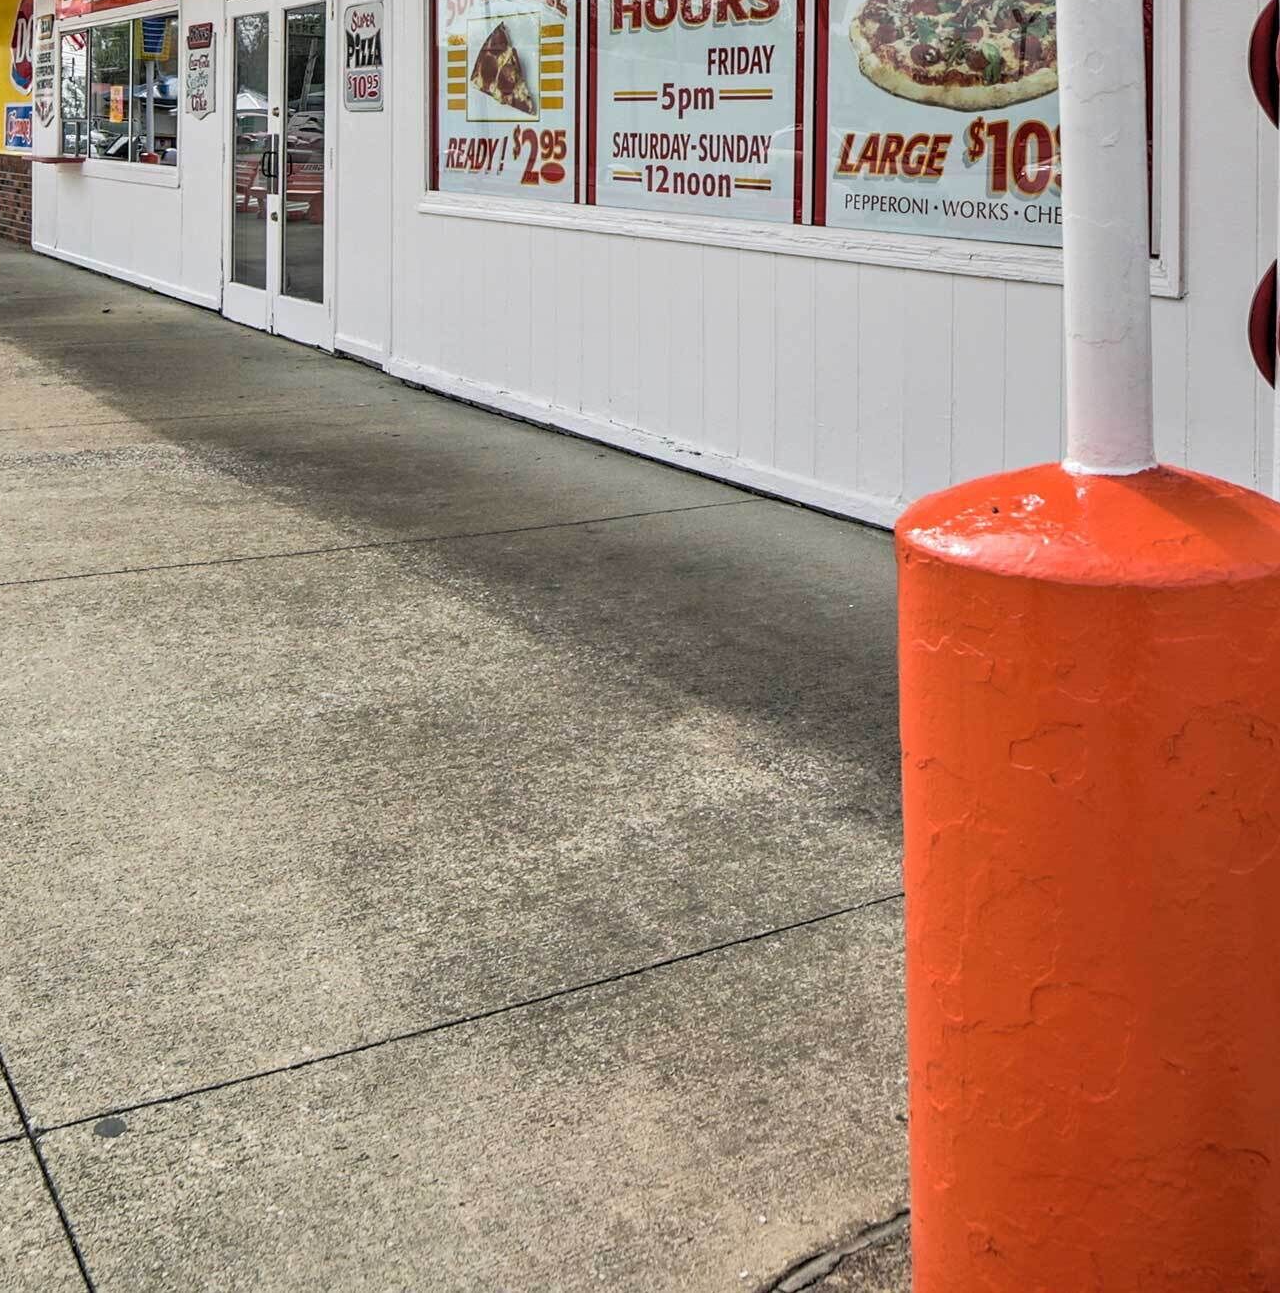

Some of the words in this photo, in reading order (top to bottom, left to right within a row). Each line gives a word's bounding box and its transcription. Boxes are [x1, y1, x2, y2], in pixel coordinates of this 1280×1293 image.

[708, 45, 775, 75] FRIDAY
[837, 134, 953, 176] LARGE
[845, 194, 928, 215] PEPPERONI
[943, 199, 1009, 221] WORKS
